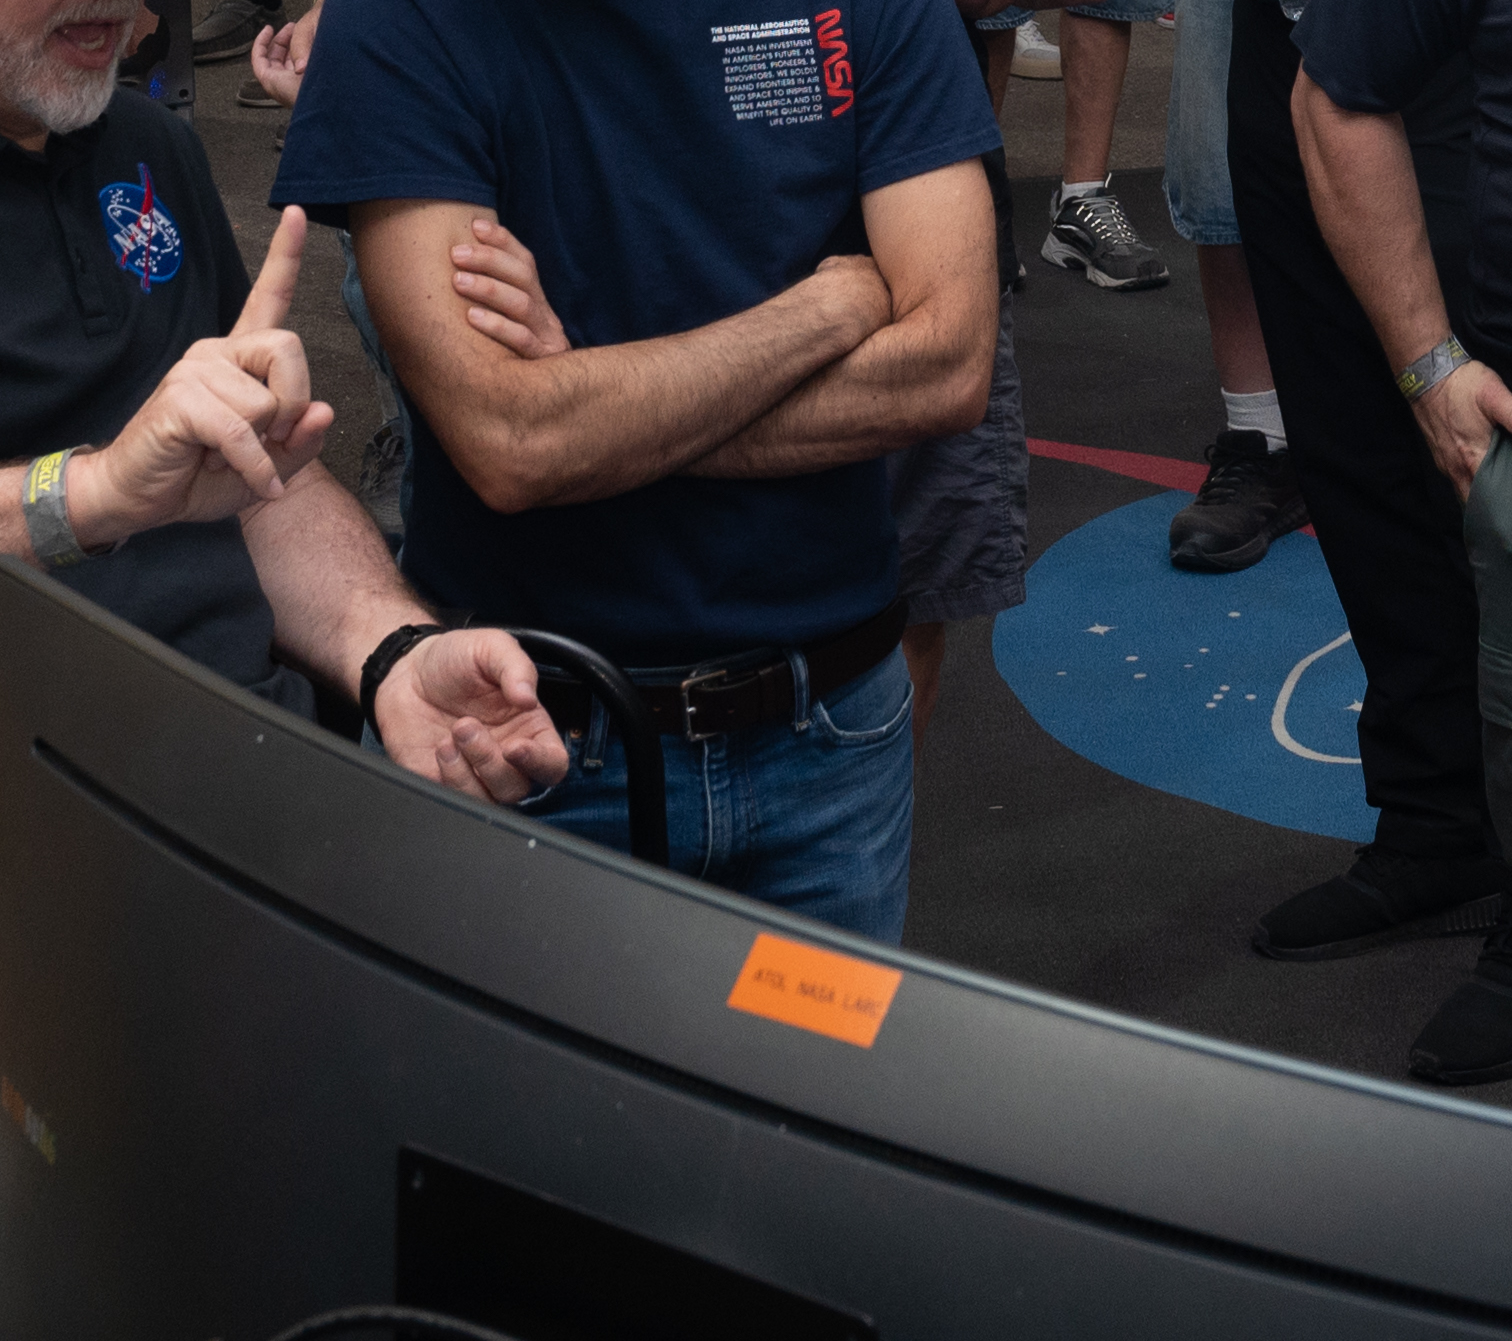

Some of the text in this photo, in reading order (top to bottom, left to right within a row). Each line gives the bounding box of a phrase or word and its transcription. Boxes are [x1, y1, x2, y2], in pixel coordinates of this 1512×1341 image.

[724, 24, 758, 33] NATIONAL
[712, 35, 726, 43] AND
[728, 32, 750, 41] SPACE
[725, 46, 745, 55] NASA
[768, 38, 813, 50] INVESTMENT
[815, 8, 854, 117] NASA
[790, 66, 818, 77] BOLDLY
[725, 83, 754, 93] EXPAND
[756, 78, 795, 89] FRONTIERS
[729, 94, 745, 102] AND
[747, 91, 771, 100] SPACE
[732, 102, 754, 111] SERVE
[756, 98, 791, 109] AMERICA
[793, 96, 810, 104] AND
[765, 109, 779, 117] THE
[781, 106, 811, 115] QUALITY
[770, 118, 783, 127] LIFE
[114, 208, 172, 255] NASA
